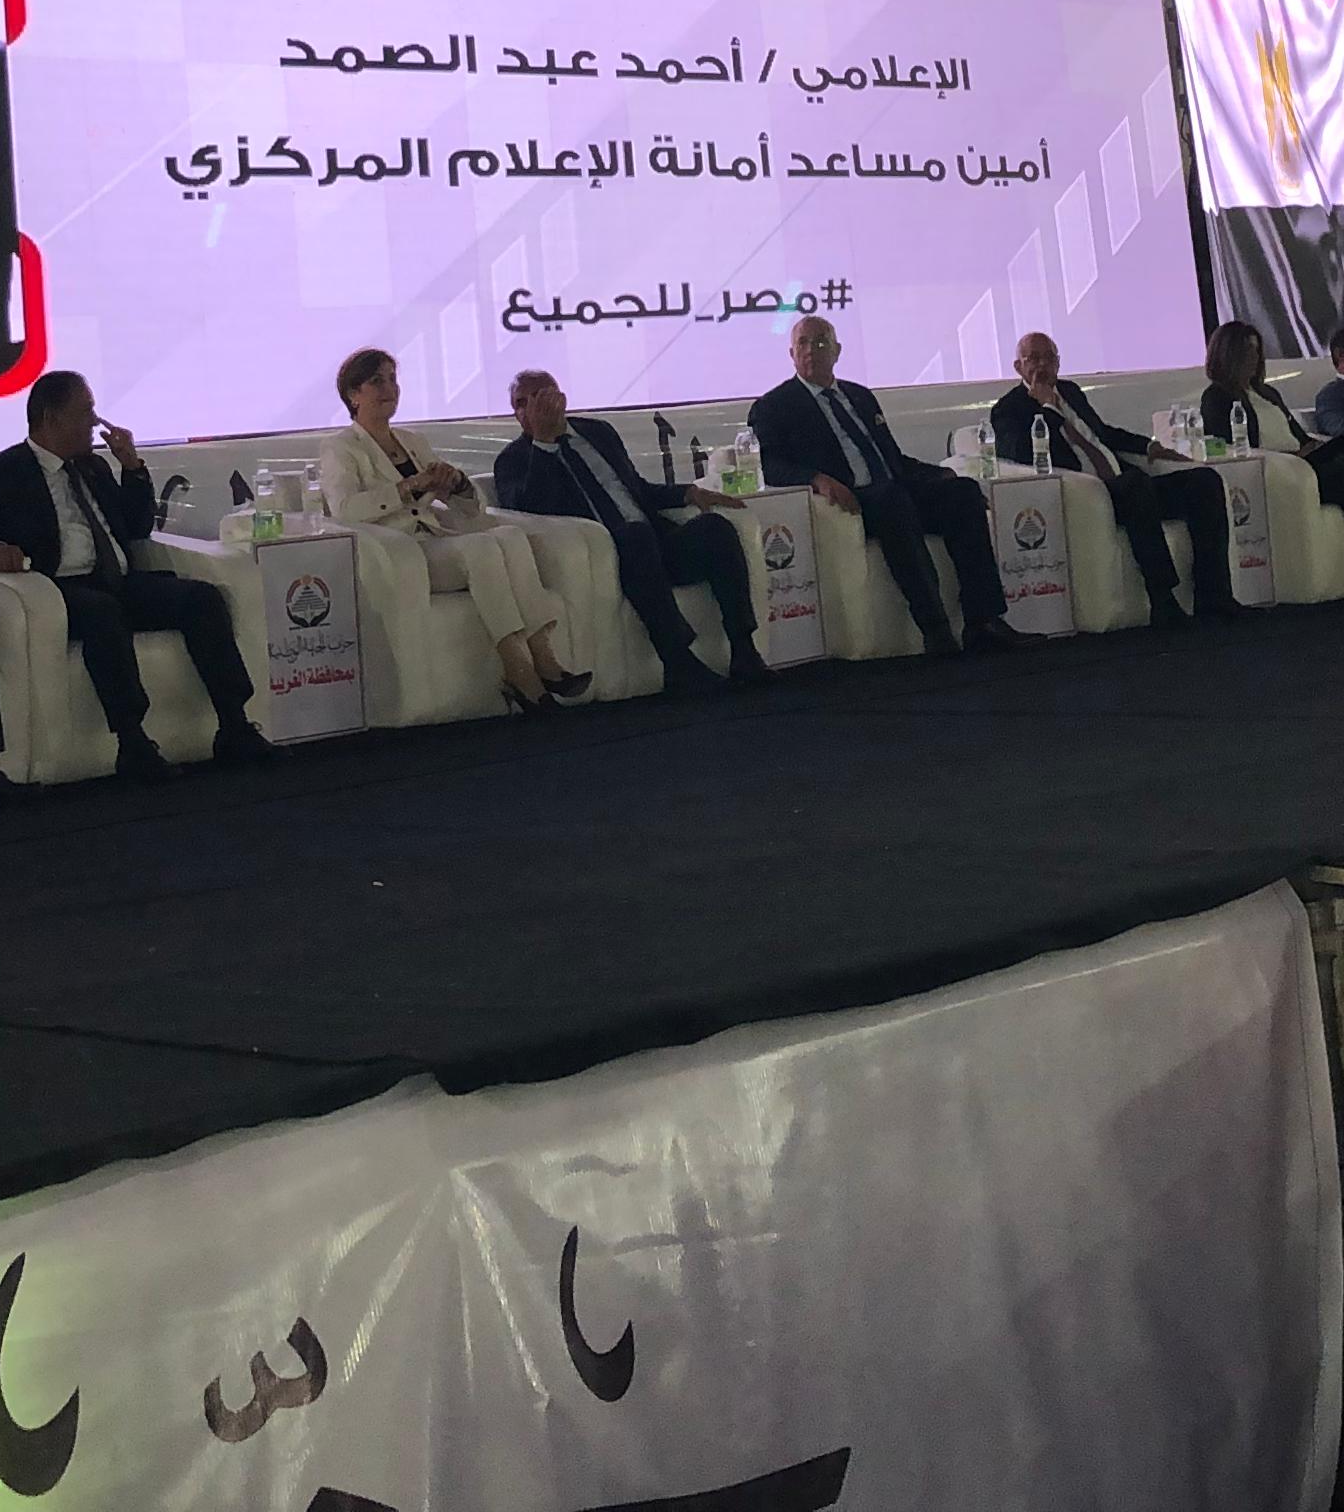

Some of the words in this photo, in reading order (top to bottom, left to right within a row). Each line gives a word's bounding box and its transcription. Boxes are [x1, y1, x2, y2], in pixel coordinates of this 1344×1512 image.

[279, 34, 477, 73] الصمد
[496, 47, 598, 85] عبد
[615, 36, 743, 85] أحمد
[792, 55, 971, 104] الإعلامي
[165, 136, 430, 201] المركزي
[448, 139, 635, 188] الإعلام
[649, 135, 771, 181] أمانة
[787, 143, 946, 182] مساعد
[956, 137, 1051, 187] أمين
[502, 278, 853, 332] #مصر_للجميع
